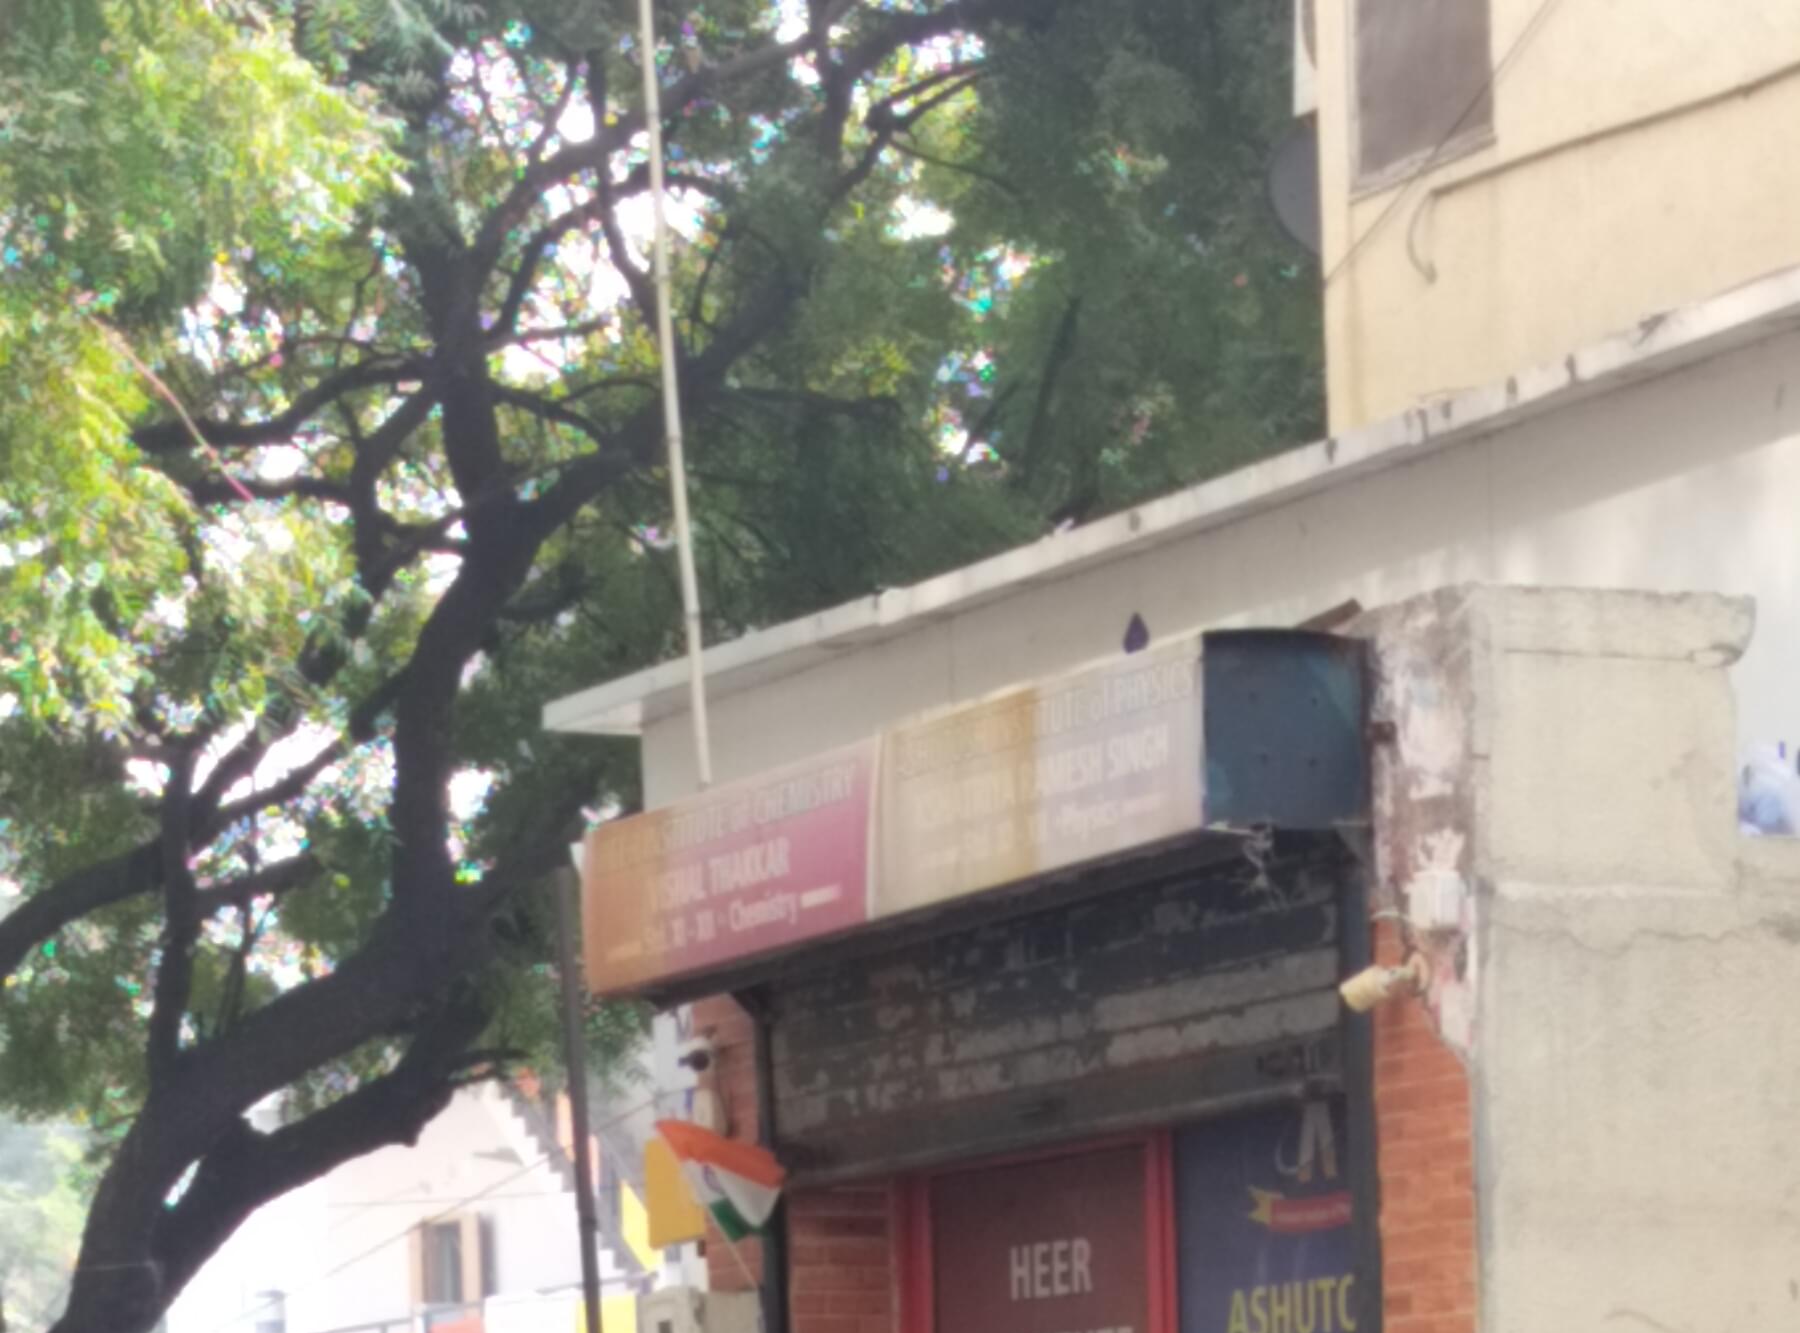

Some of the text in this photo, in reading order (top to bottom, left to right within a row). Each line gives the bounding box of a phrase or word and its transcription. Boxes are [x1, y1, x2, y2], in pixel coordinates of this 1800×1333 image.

[1112, 657, 1194, 715] PHYSICS
[1106, 722, 1169, 781] SINGH
[753, 764, 857, 827] CHEMISTRY
[1010, 1237, 1092, 1300] HEER
